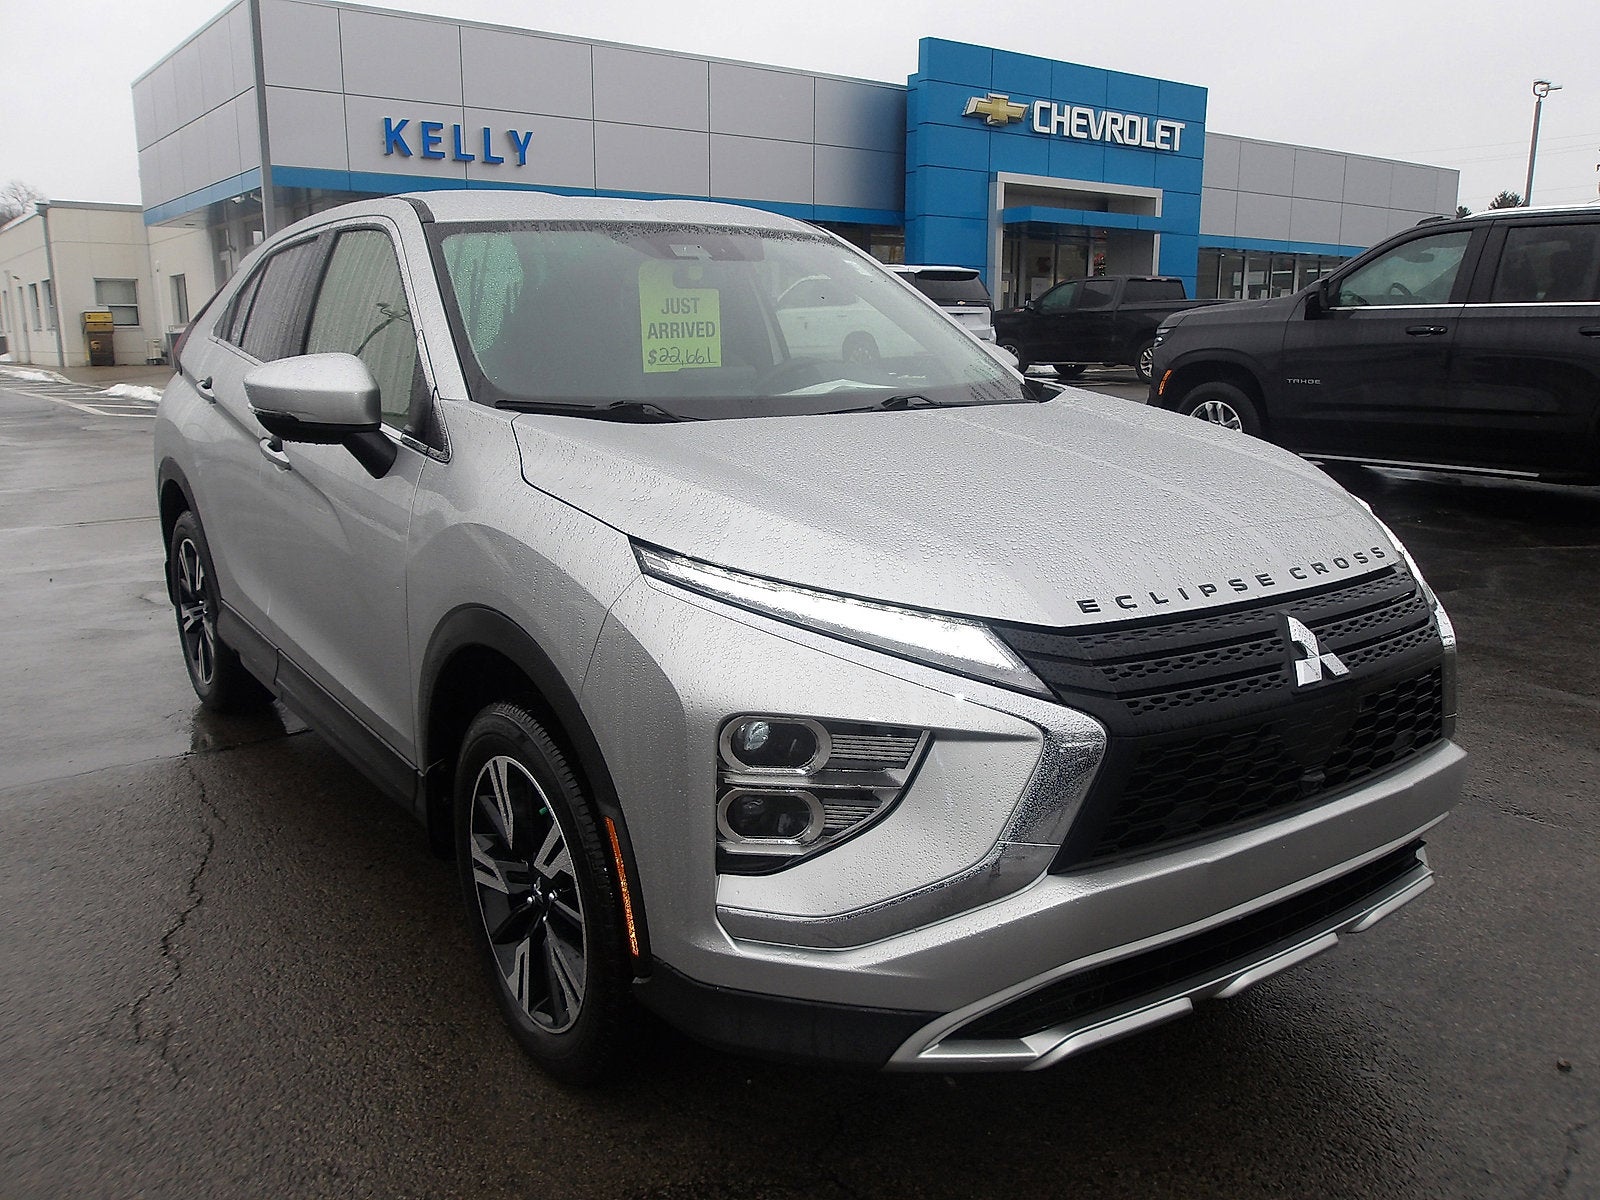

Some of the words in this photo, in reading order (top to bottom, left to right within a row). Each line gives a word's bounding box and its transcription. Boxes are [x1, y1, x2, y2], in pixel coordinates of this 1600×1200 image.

[383, 116, 534, 166] KELLY
[1032, 99, 1186, 152] CHEVROLET
[647, 321, 716, 339] ARRIVED
[661, 297, 700, 315] JUST
[1076, 573, 1275, 614] ECLIPSE
[1289, 546, 1386, 580] CROSS
